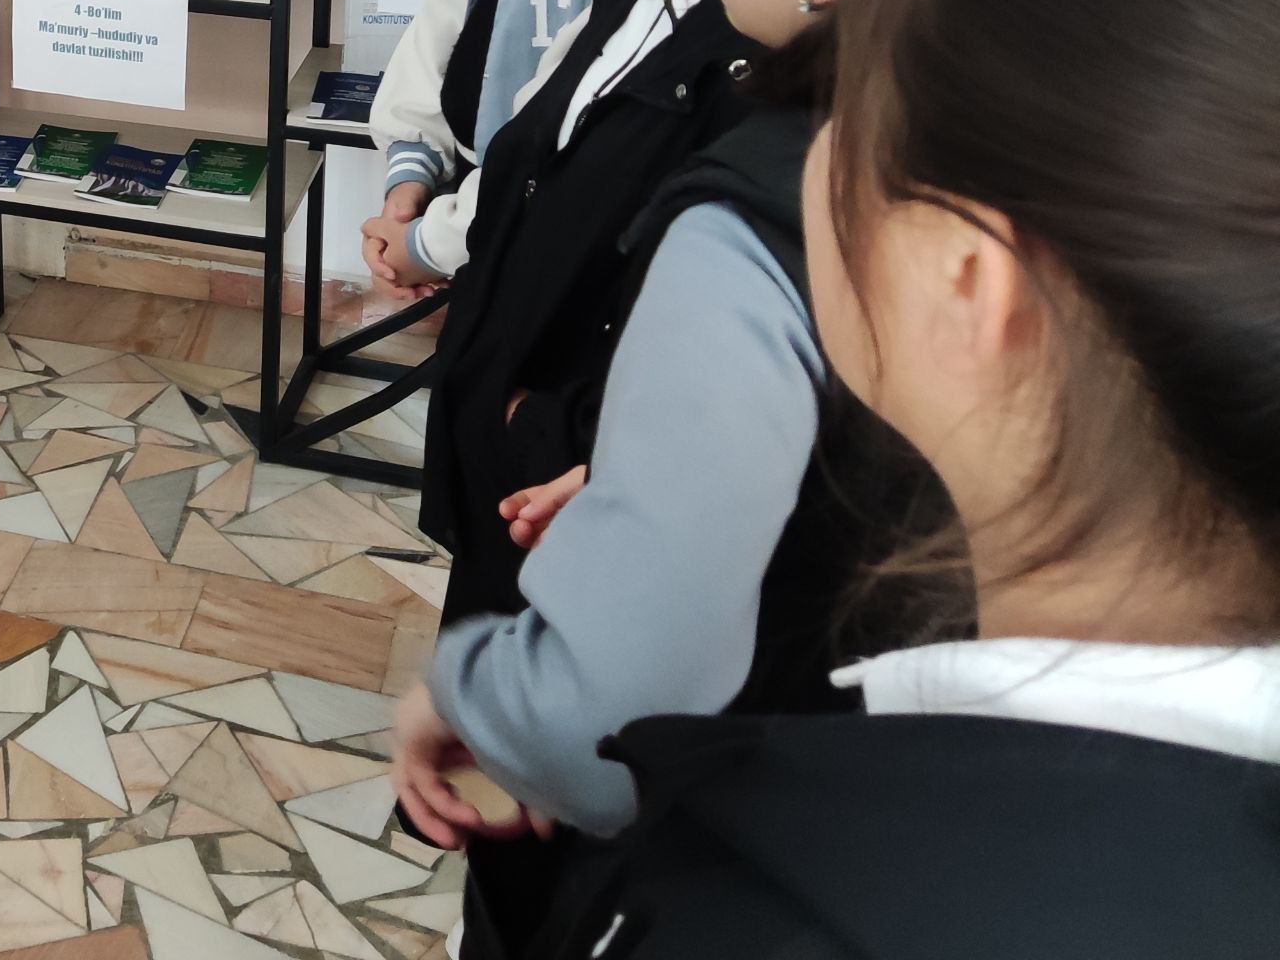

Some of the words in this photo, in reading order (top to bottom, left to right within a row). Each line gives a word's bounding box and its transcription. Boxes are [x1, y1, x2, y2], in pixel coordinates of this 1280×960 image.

[74, 4, 81, 16] 4
[145, 34, 158, 45] va
[52, 41, 86, 55] davlat
